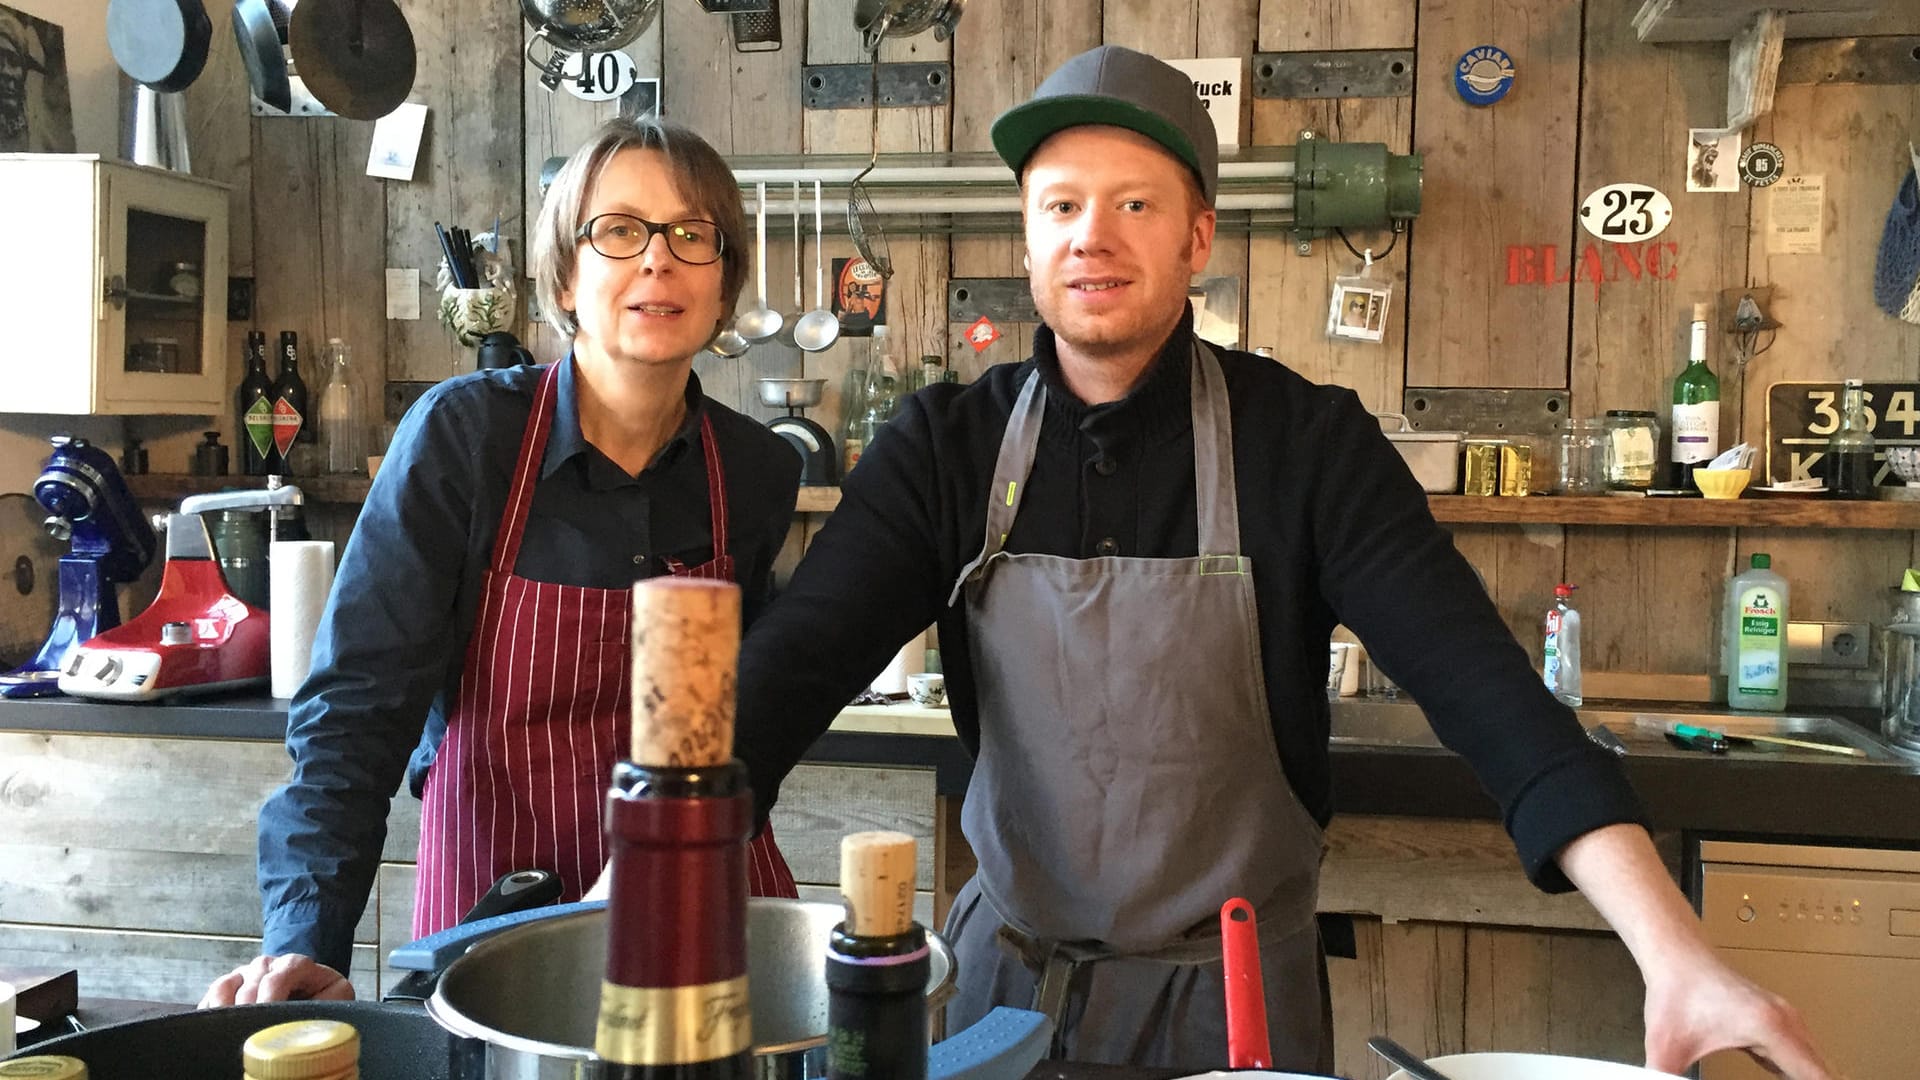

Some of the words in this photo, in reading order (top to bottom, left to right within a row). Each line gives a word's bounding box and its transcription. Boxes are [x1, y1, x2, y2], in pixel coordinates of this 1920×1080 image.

[576, 52, 620, 94] 40
[1602, 190, 1655, 235] 23
[1505, 241, 1678, 286] BLANC
[1744, 606, 1776, 615] Frosch
[1744, 625, 1776, 634] Reiniger
